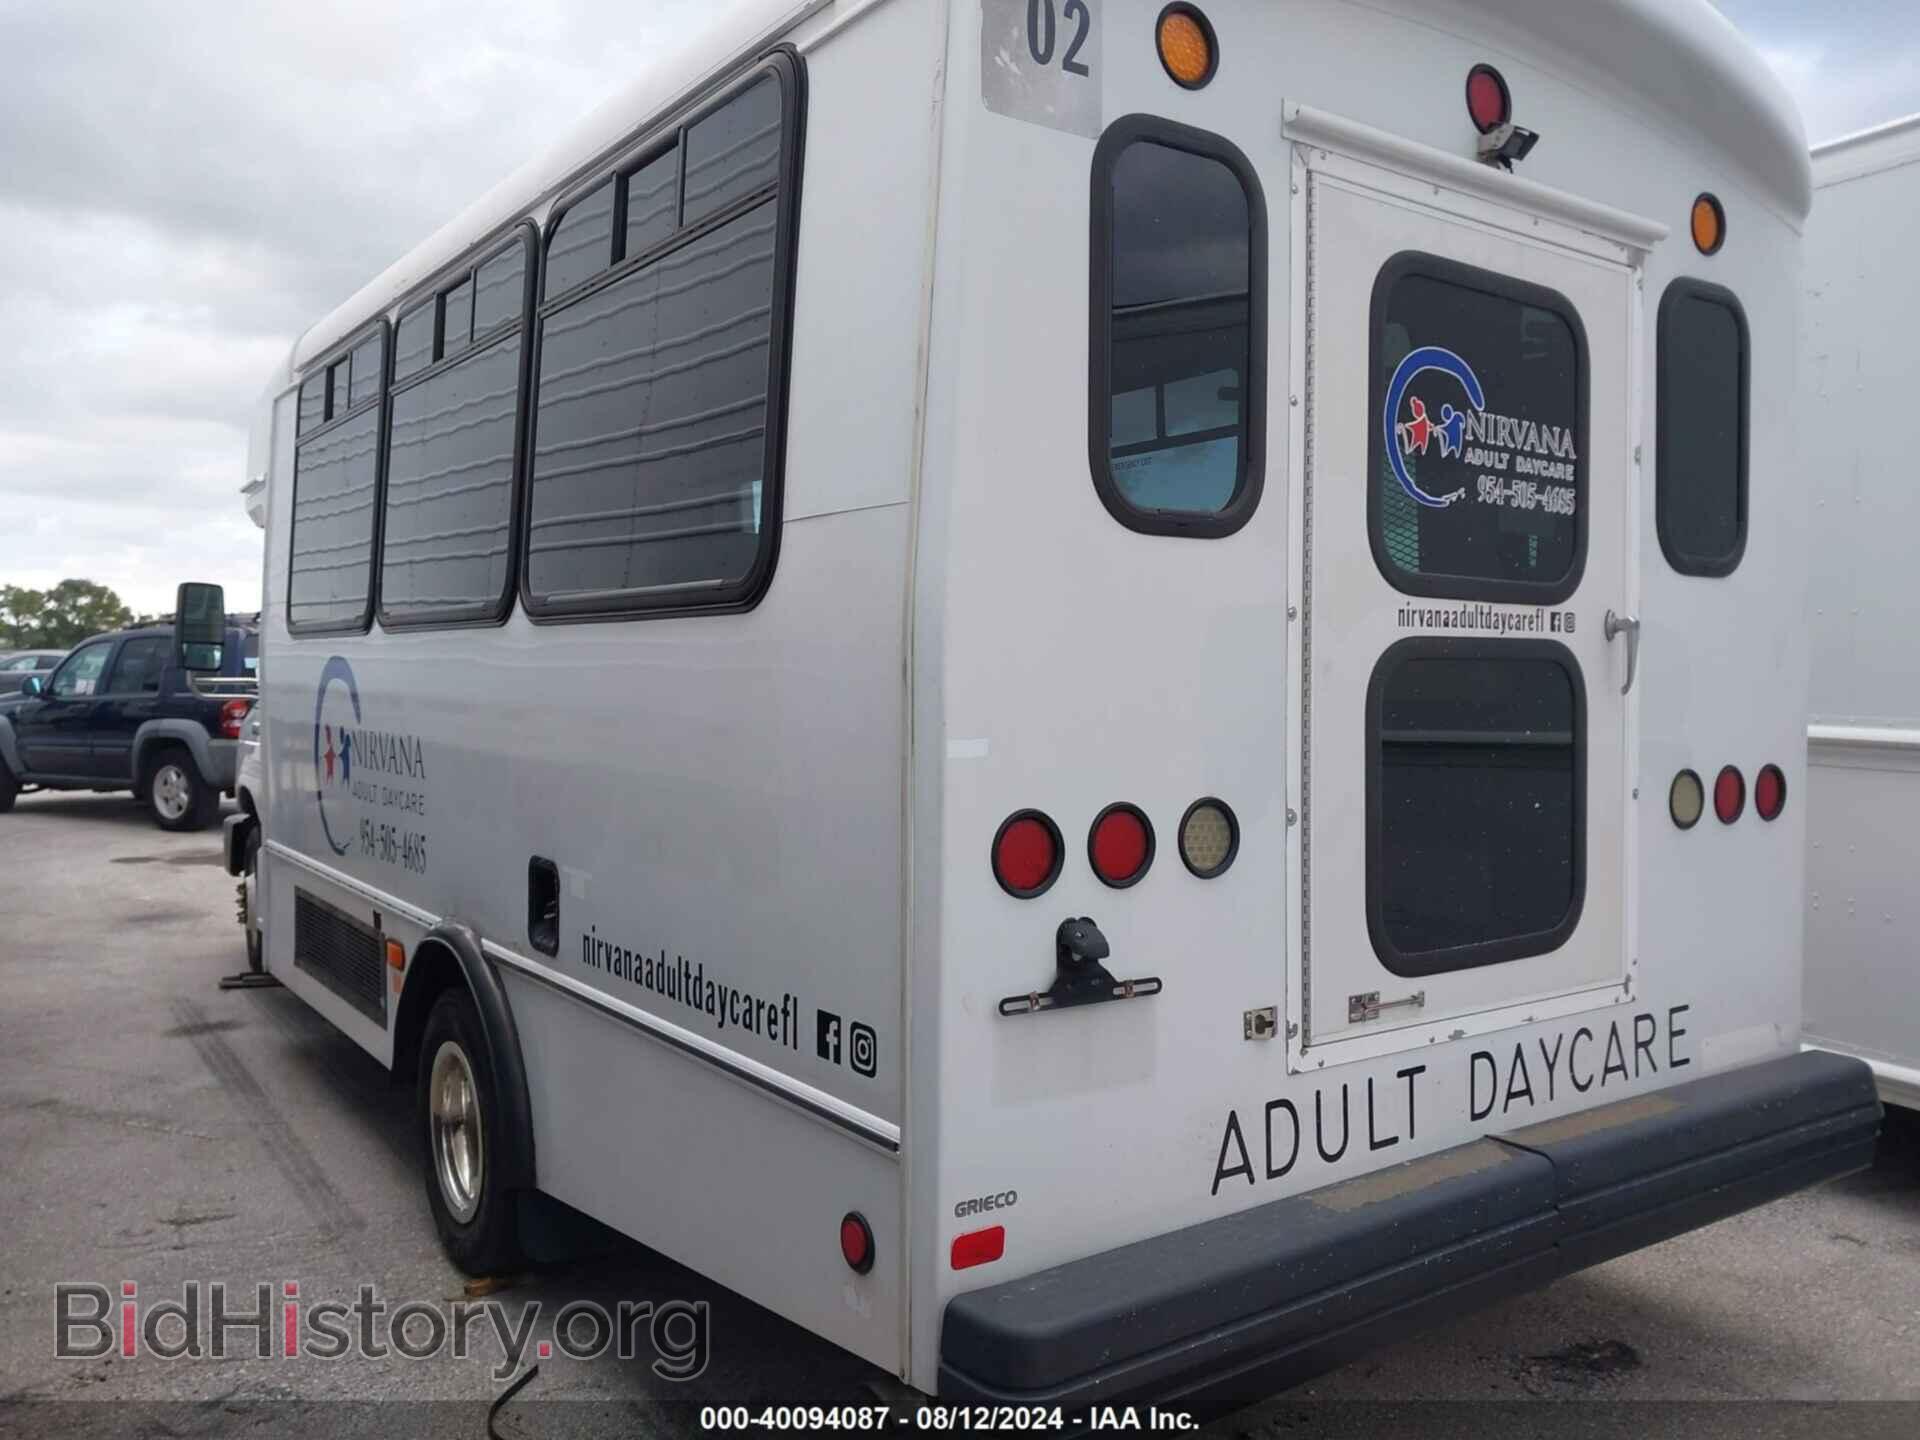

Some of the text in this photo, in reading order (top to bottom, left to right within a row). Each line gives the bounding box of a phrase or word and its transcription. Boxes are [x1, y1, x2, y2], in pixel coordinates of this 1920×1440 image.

[1027, 0, 1090, 77] 02
[1464, 409, 1577, 460] NIRVANA
[1464, 447, 1575, 482] ADULT DAYCARE
[1397, 601, 1545, 636] nirvanaadultdaycarefl
[352, 729, 426, 780] NIRVANA
[382, 785, 425, 817] DAYCARE
[582, 924, 799, 1051] nirvanaadultdaycarefl
[1211, 1004, 1691, 1197] ADULT DAYCARE
[953, 1189, 1018, 1218] GRIECO
